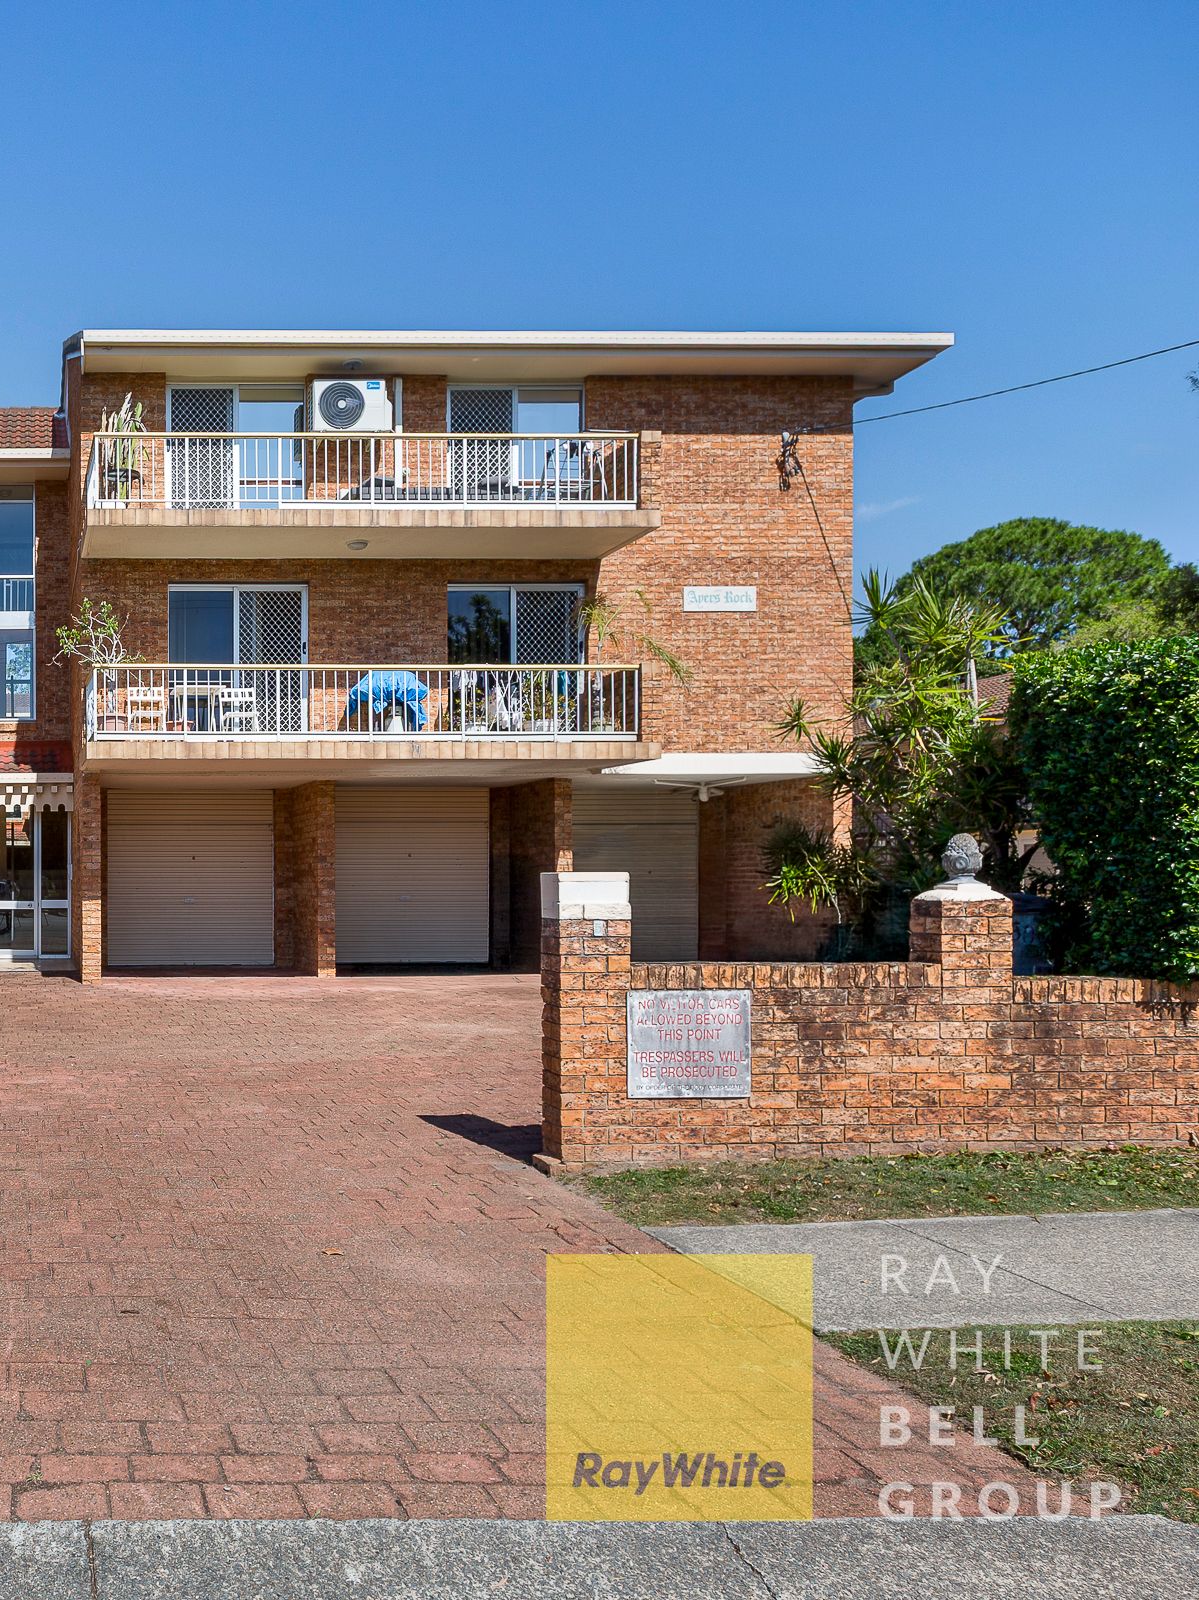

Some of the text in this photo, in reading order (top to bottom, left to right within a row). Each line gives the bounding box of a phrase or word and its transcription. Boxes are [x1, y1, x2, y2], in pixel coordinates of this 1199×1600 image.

[724, 590, 753, 604] Rock
[638, 999, 655, 1010] NO
[709, 999, 740, 1010] CARS
[696, 1013, 743, 1025] BEYOND
[658, 1028, 722, 1041] THIS POINT
[634, 1050, 746, 1063] TRESPASSERS WILL
[641, 1066, 738, 1078] BE PROSECUTED
